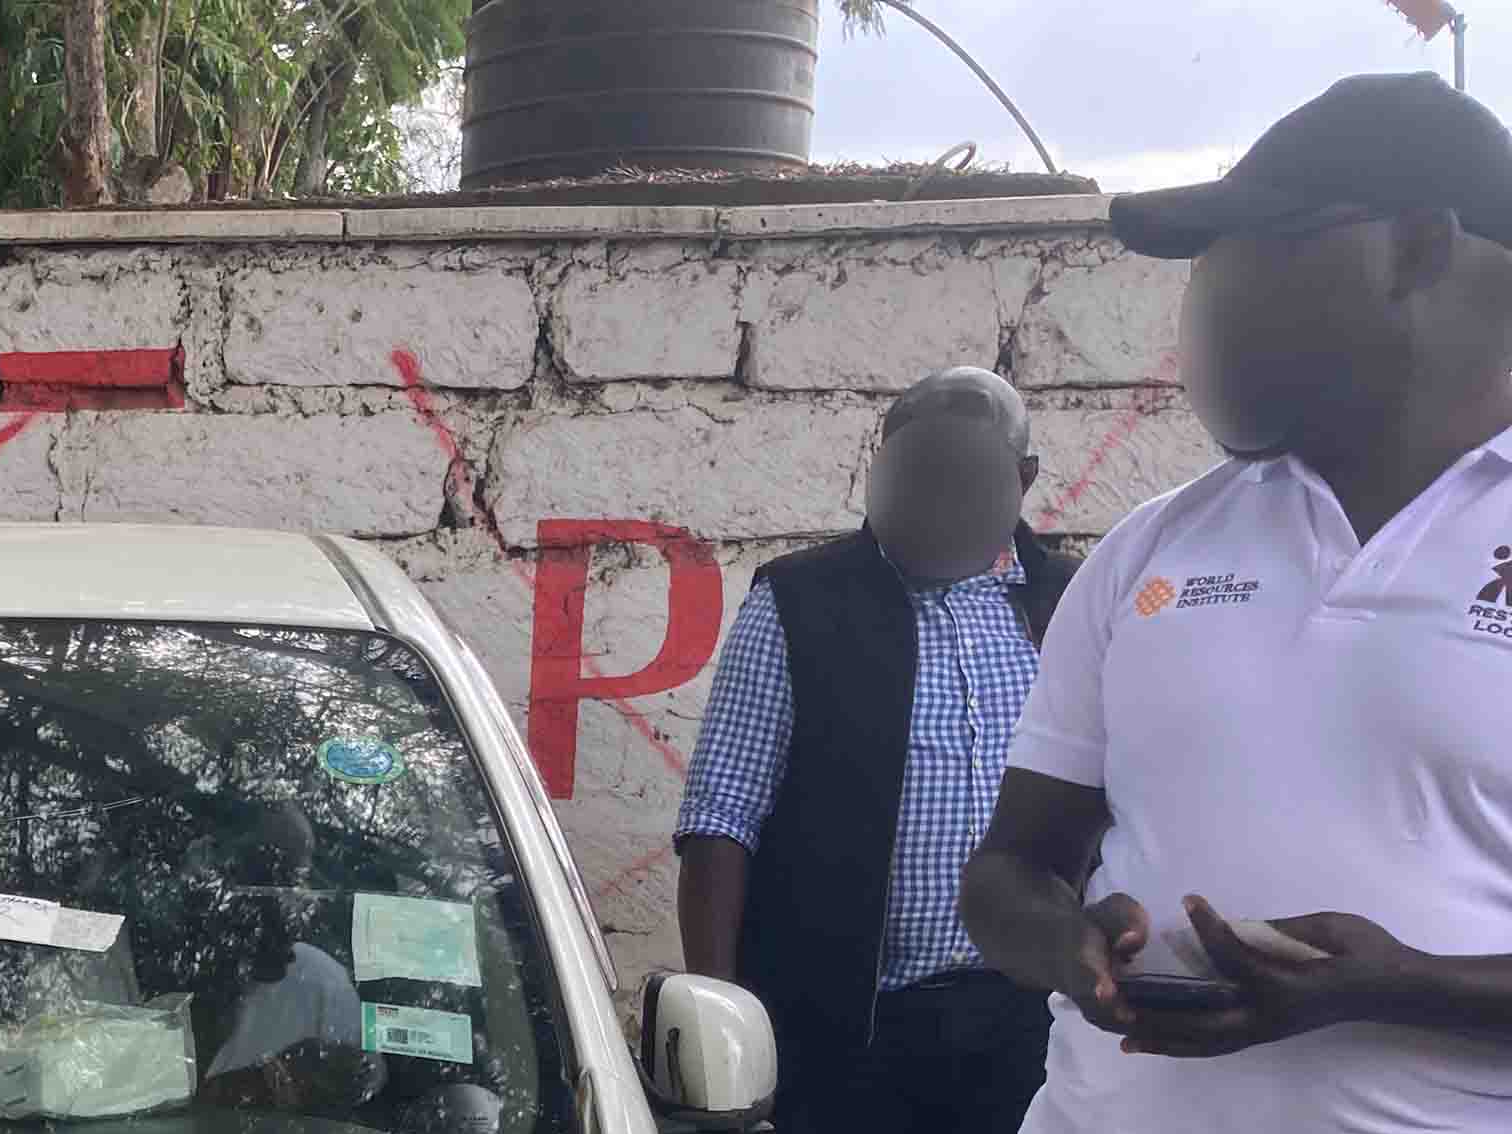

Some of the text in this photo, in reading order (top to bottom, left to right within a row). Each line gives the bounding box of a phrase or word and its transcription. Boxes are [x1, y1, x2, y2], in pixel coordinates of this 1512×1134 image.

[1187, 574, 1235, 586] WORLD
[1180, 580, 1259, 598] RESOURCES
[1176, 593, 1251, 608] INSTITUTE
